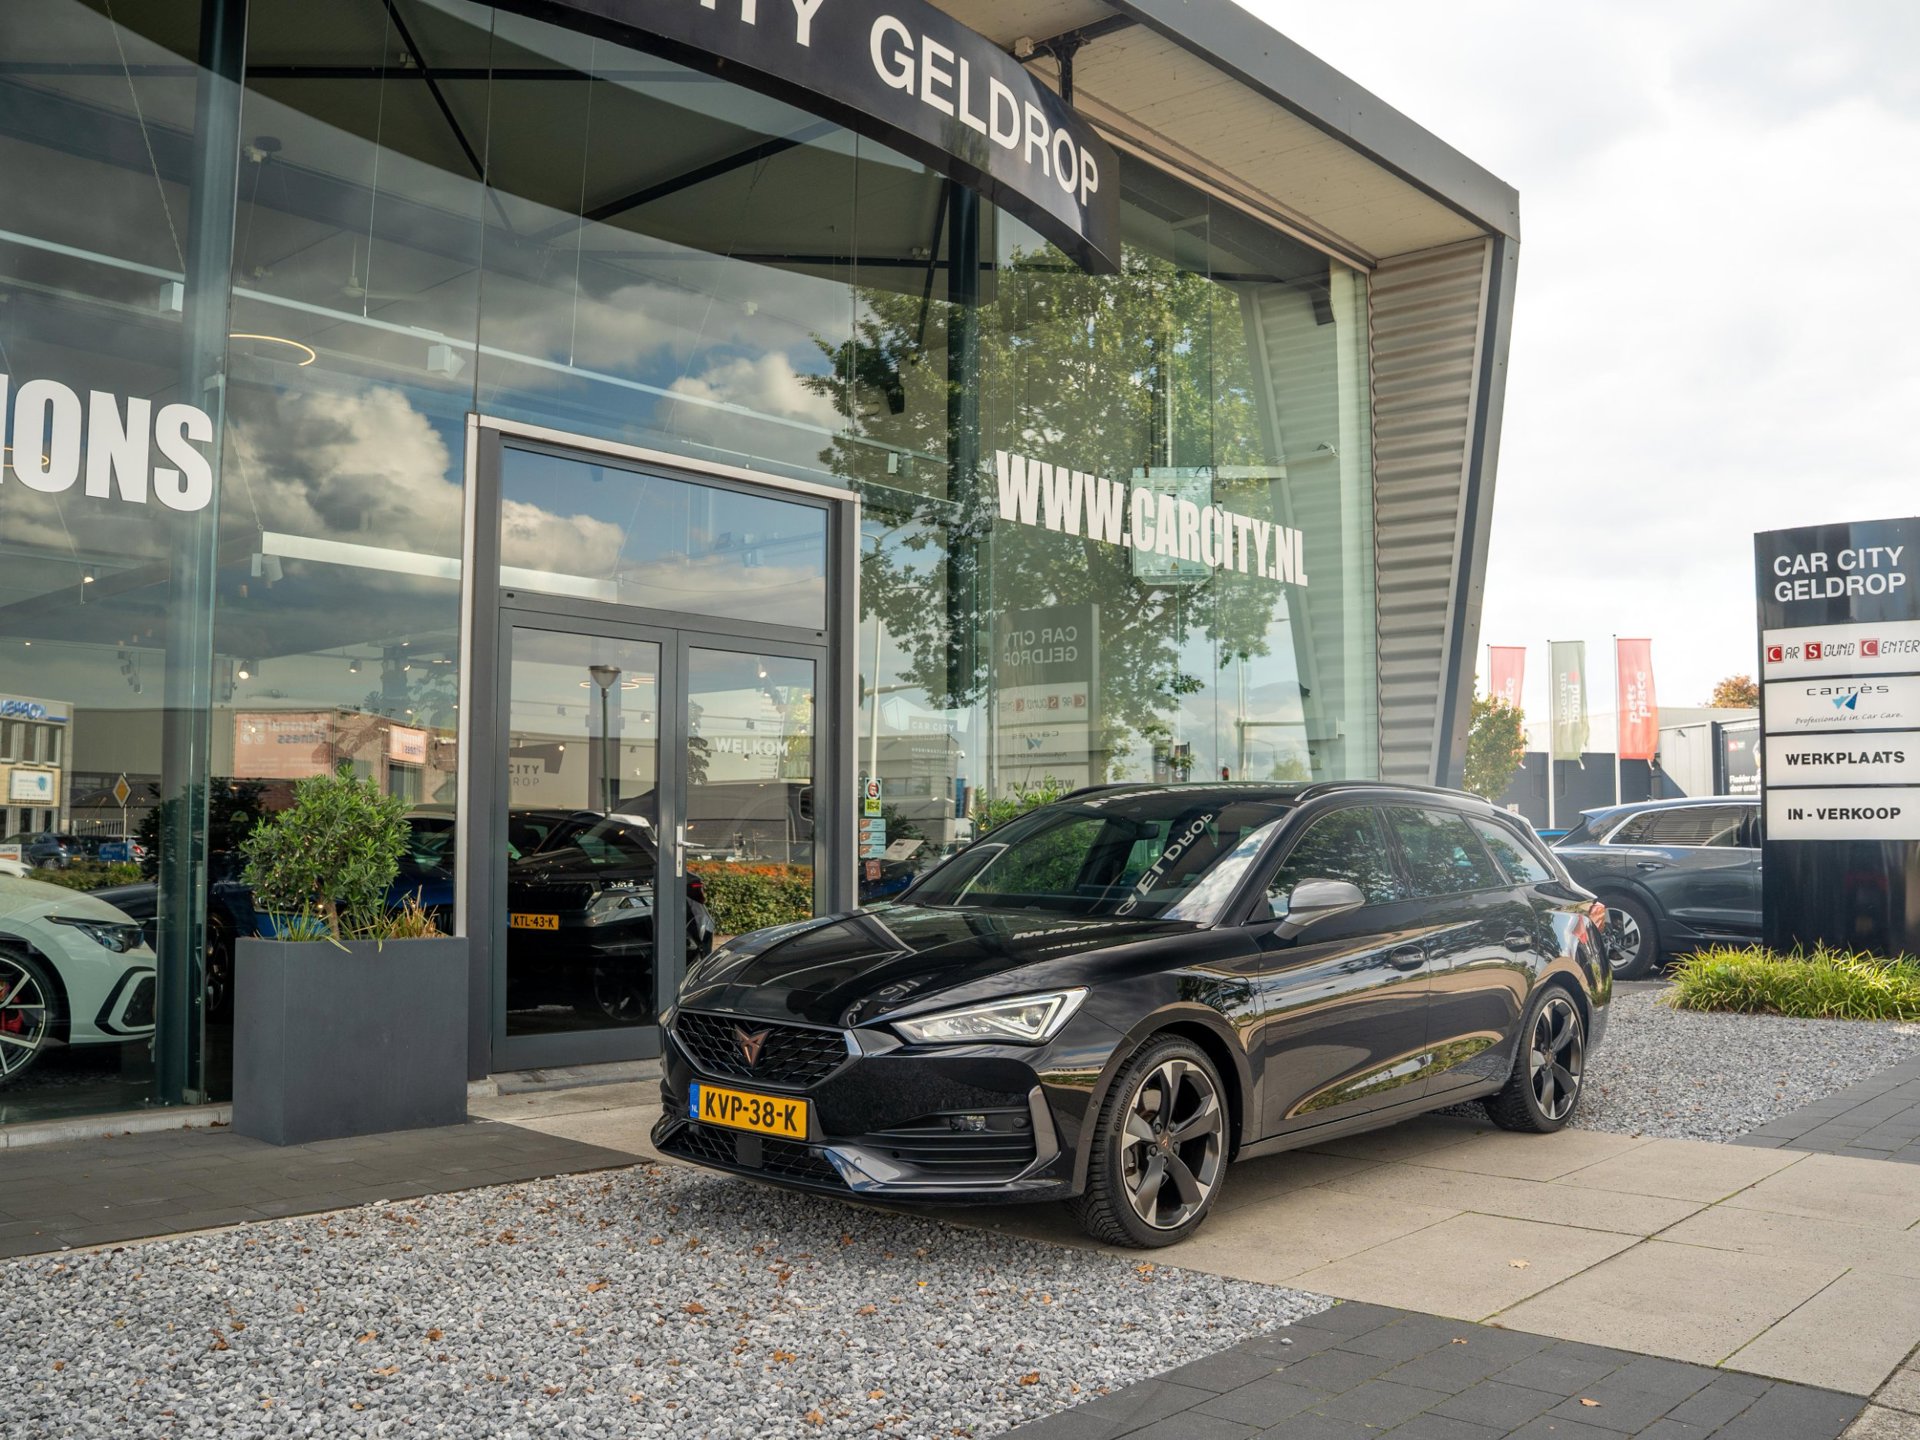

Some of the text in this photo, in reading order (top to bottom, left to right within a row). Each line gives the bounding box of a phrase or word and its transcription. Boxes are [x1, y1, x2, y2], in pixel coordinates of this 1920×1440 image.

[870, 15, 1099, 207] GELDROP
[996, 450, 1308, 586] WWW.CARCITY.NL
[1774, 546, 1904, 576] CAR CITY
[1775, 573, 1906, 602] GELDROP
[1636, 671, 1652, 718] place
[1806, 683, 1889, 696] carrès
[1626, 684, 1642, 724] pets
[1849, 713, 1859, 721] in
[715, 737, 789, 756] WELKOM
[1786, 751, 1905, 765] WERKPLAATS
[1788, 808, 1803, 820] IN
[1817, 807, 1901, 820] VERKOOP
[513, 915, 554, 928] KTL-43-K
[691, 1104, 698, 1113] NL
[705, 1091, 798, 1132] KVP-38-K
